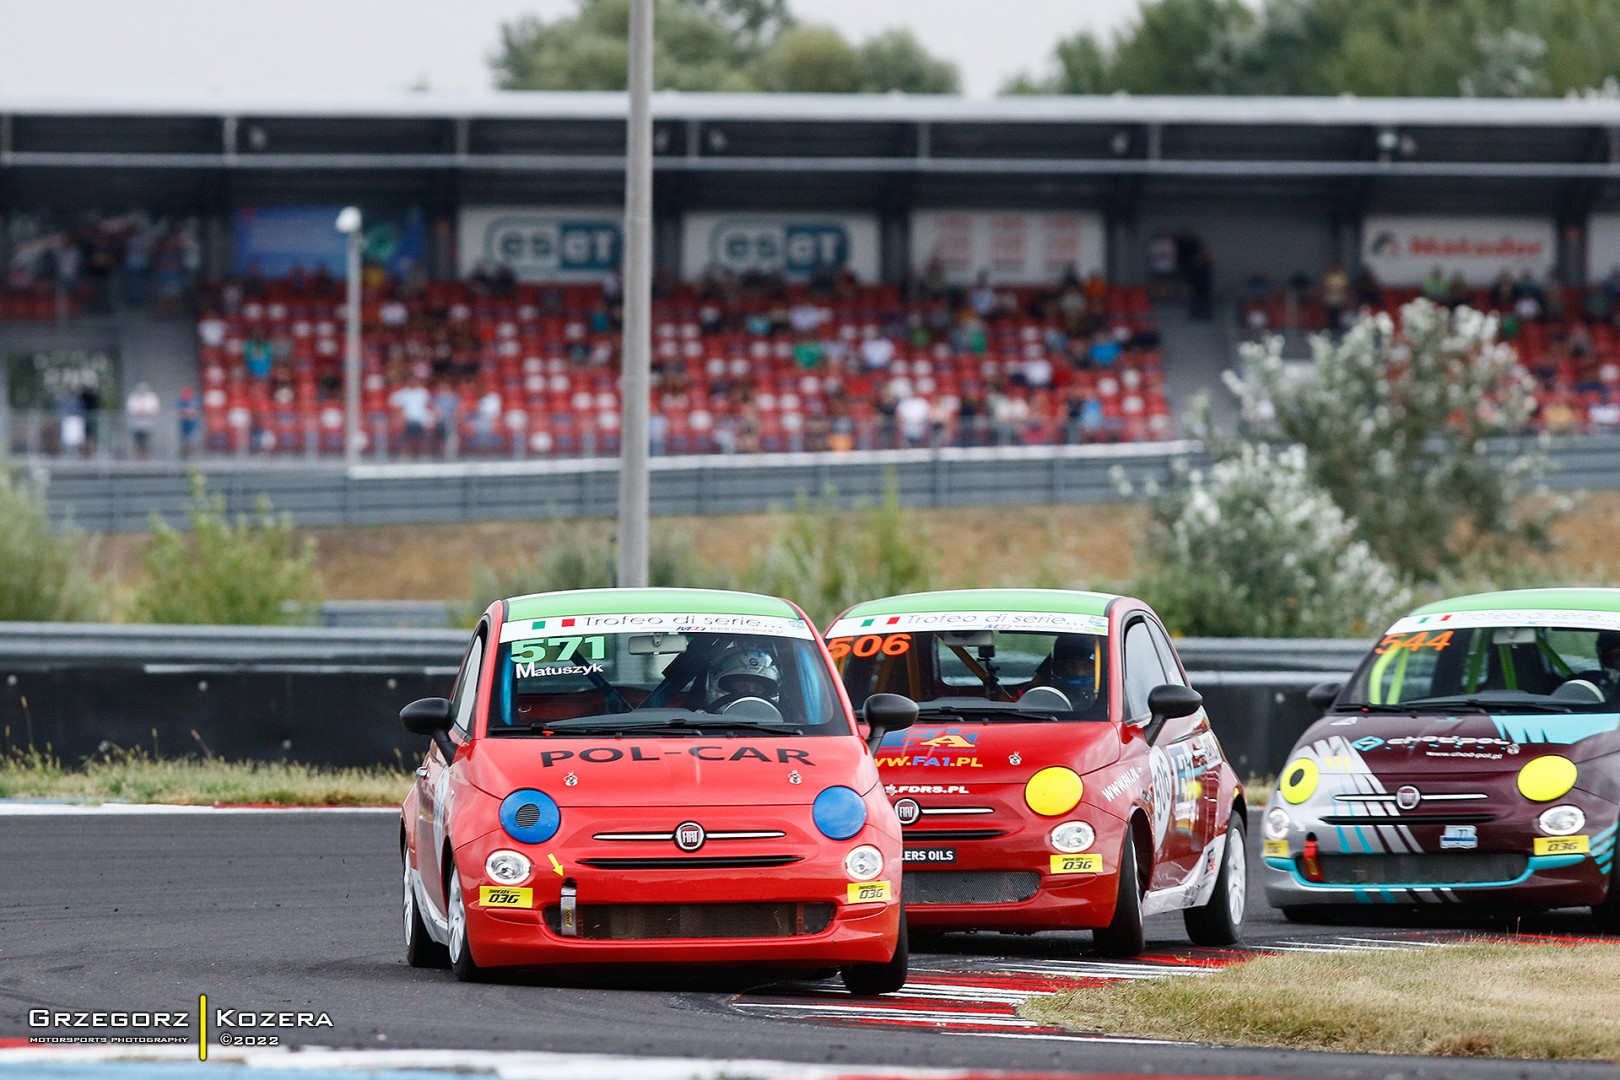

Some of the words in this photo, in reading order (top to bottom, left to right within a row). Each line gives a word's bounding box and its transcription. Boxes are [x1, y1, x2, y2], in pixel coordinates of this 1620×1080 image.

[583, 615, 663, 627] Trofeo
[673, 615, 695, 625] di
[908, 613, 977, 625] Trofeo
[985, 613, 1009, 623] di
[827, 633, 912, 659] 506
[1375, 630, 1455, 655] 544
[510, 635, 605, 664] 571
[516, 661, 604, 679] Matuszyk
[541, 745, 816, 768] POL-CAR
[899, 806, 914, 818] FIAT
[682, 830, 699, 844] FIAT
[928, 850, 954, 861] OILS
[1062, 860, 1093, 870] 03G
[488, 893, 521, 904] 03G
[859, 889, 884, 899] 03G
